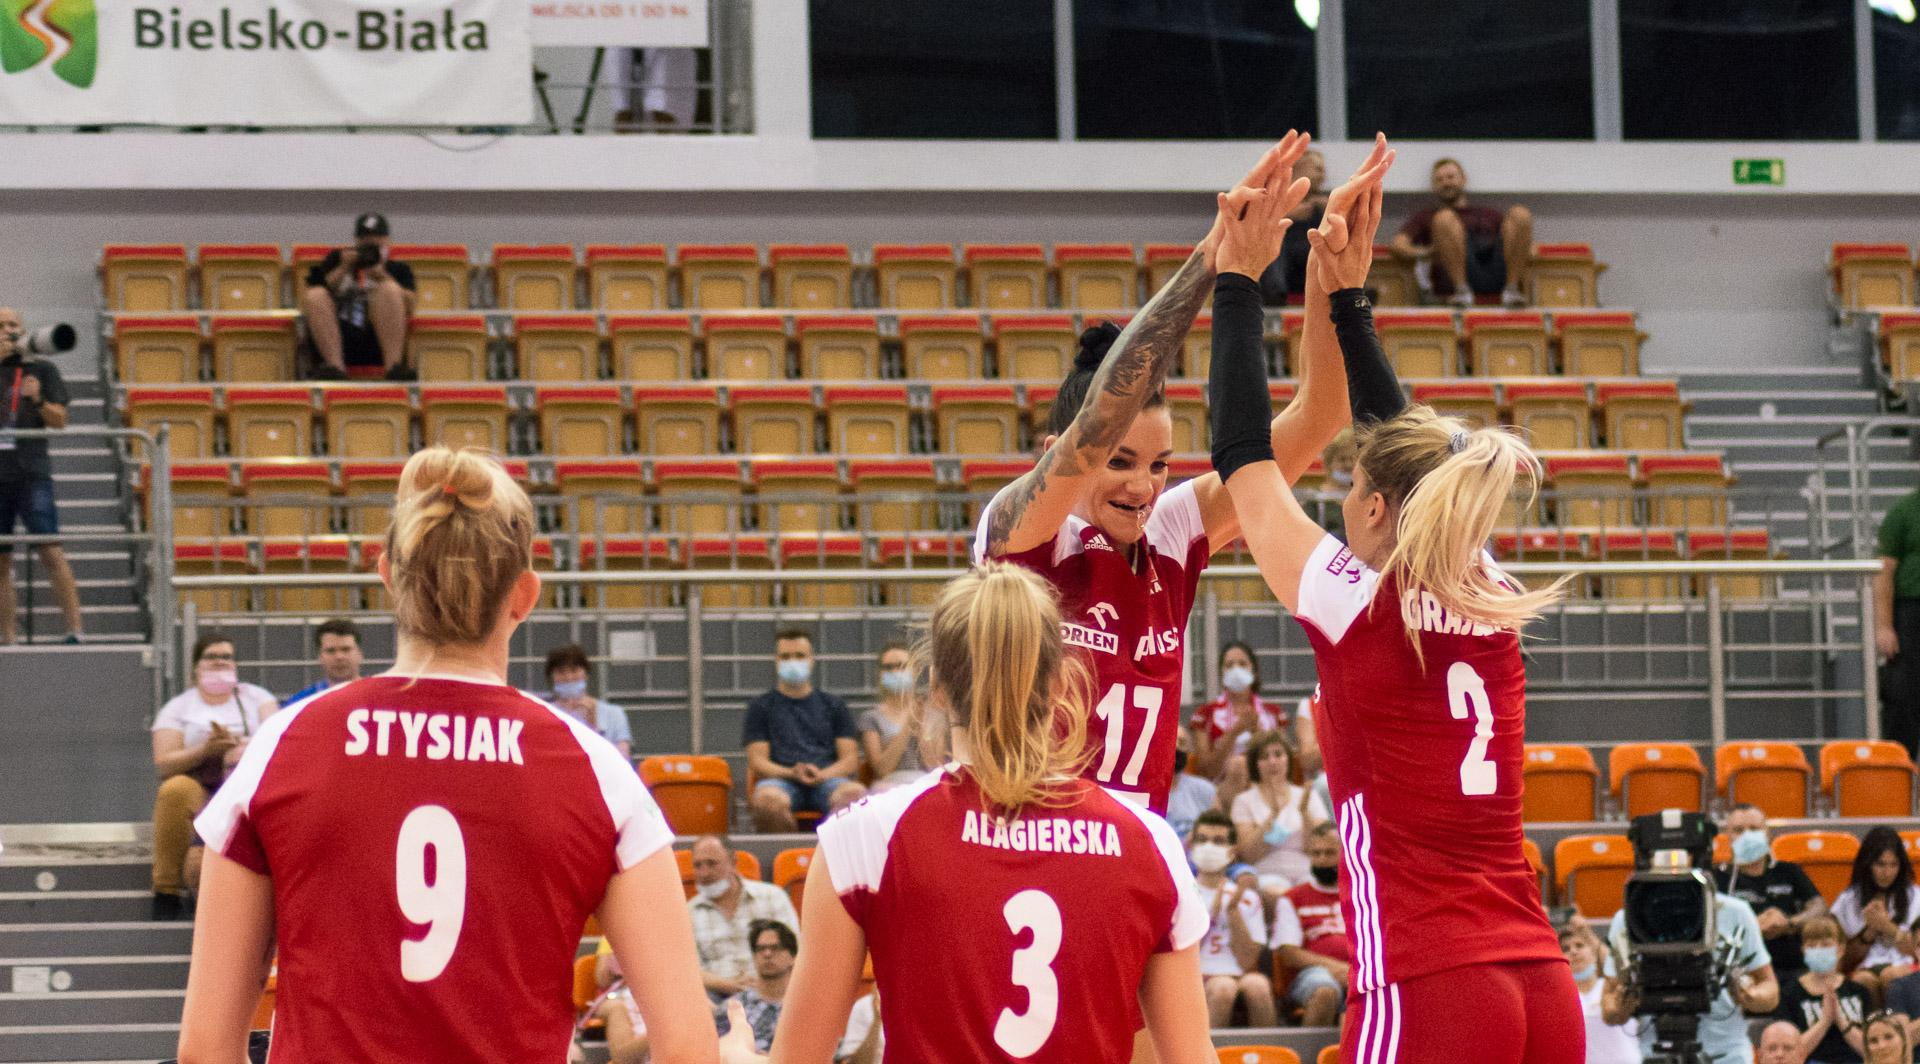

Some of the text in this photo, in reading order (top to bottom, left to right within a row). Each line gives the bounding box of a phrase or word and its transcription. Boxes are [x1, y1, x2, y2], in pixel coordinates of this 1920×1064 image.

[134, 8, 488, 50] Bielsko-Biała
[1084, 543, 1114, 552] adidas
[345, 709, 524, 766] STYSIAK
[1096, 683, 1163, 786] 17
[1447, 662, 1497, 795] 2
[961, 810, 1122, 857] ALAGIERSKA
[396, 805, 466, 982] 9
[993, 889, 1062, 1058] 3
